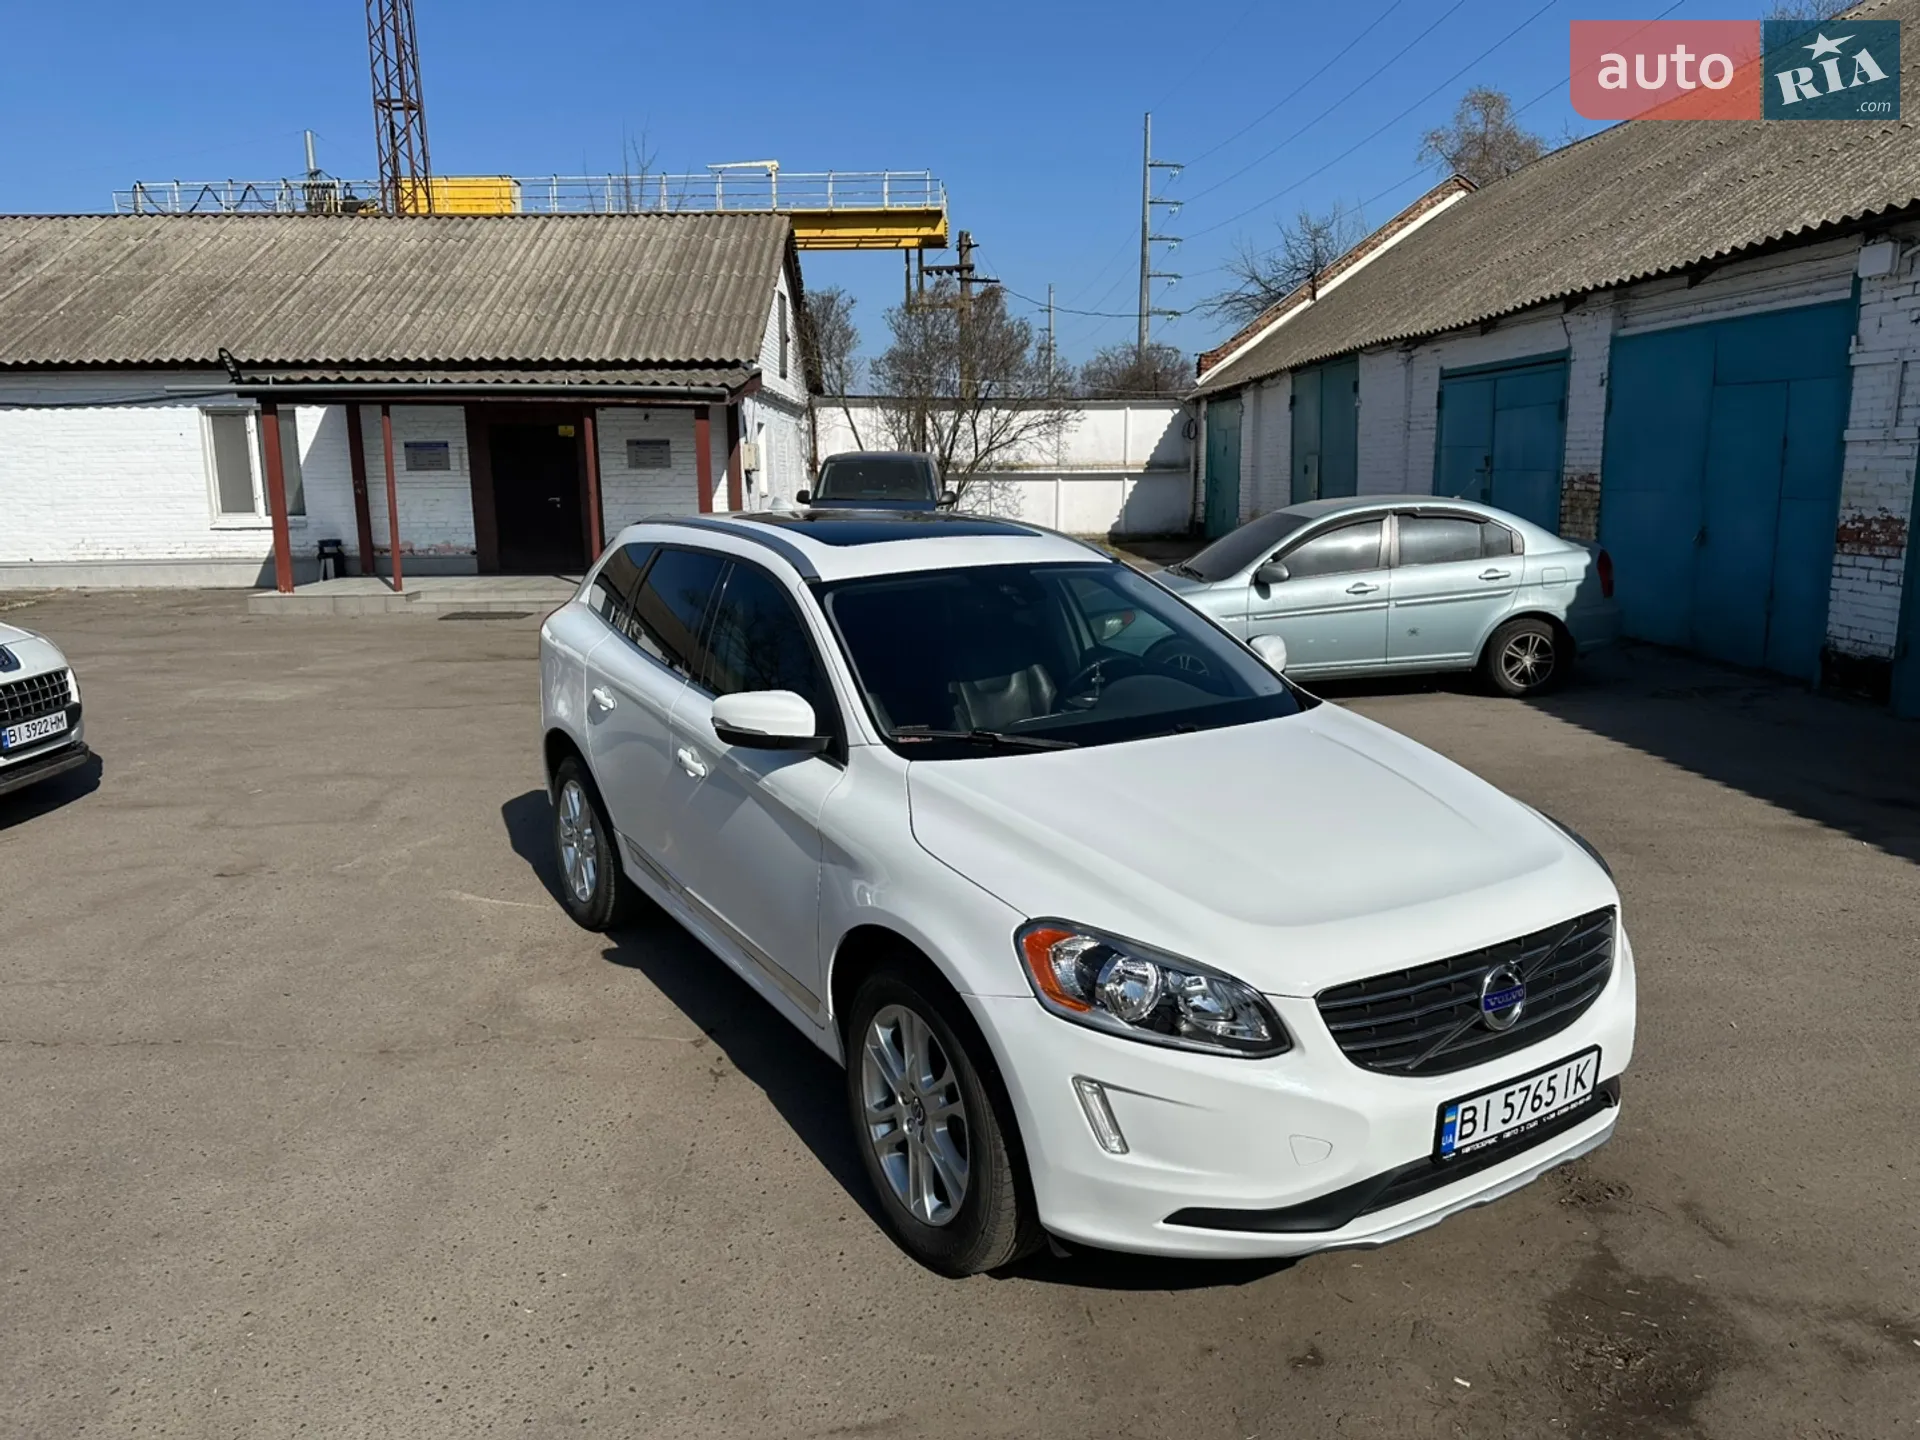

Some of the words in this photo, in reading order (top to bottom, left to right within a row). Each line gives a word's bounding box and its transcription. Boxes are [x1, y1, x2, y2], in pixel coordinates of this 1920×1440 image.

[8, 727, 22, 744] BI
[25, 718, 49, 739] 3922
[50, 715, 65, 732] HM
[1487, 988, 1524, 1006] VOLVO
[1458, 1099, 1491, 1141] BI
[1501, 1073, 1558, 1125] 5765
[1563, 1058, 1591, 1099] IK
[1442, 1134, 1454, 1146] UA
